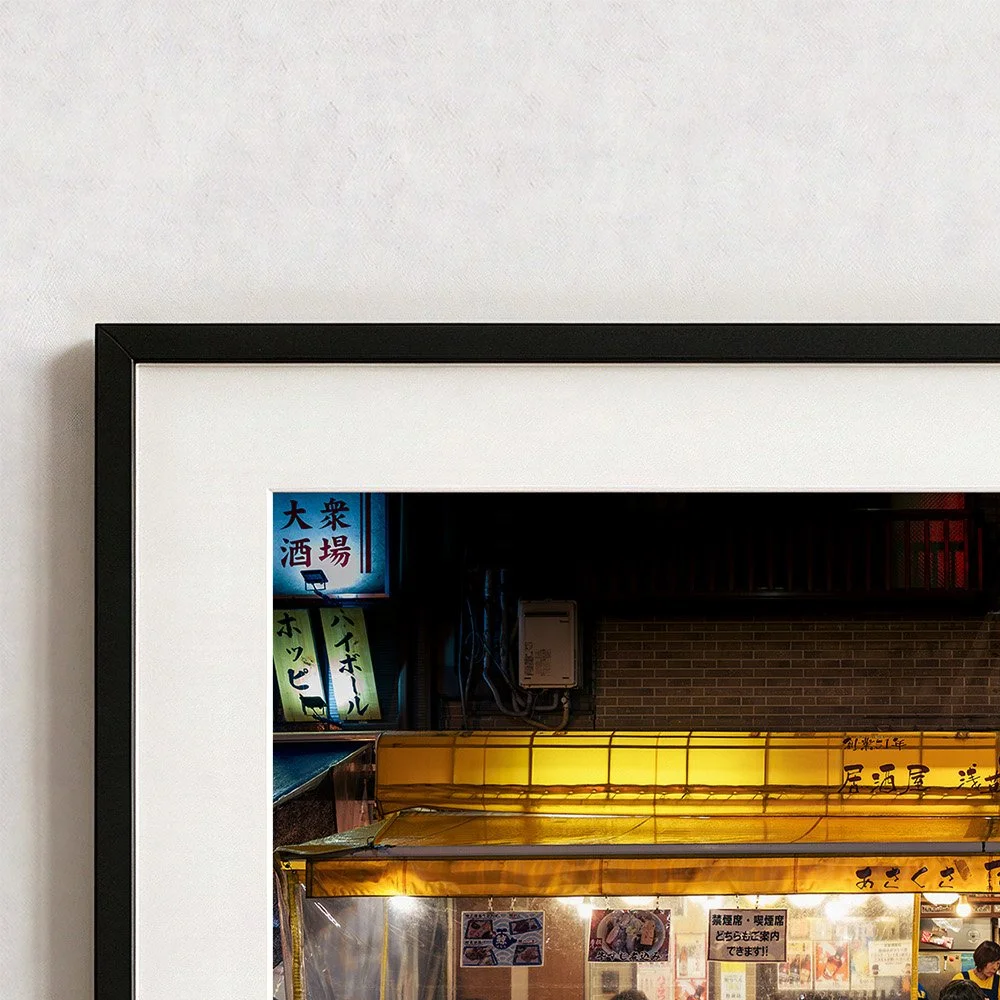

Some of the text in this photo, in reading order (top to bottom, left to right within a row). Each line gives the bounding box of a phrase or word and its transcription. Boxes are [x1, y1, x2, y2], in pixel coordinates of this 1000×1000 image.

[279, 497, 352, 532] 大衆
[279, 534, 352, 569] 酒場
[330, 611, 370, 716] ハイボール
[837, 763, 931, 795] 居酒屋
[711, 914, 785, 927] 禁煙席・喫煙席
[715, 930, 780, 943] どちらもご案内
